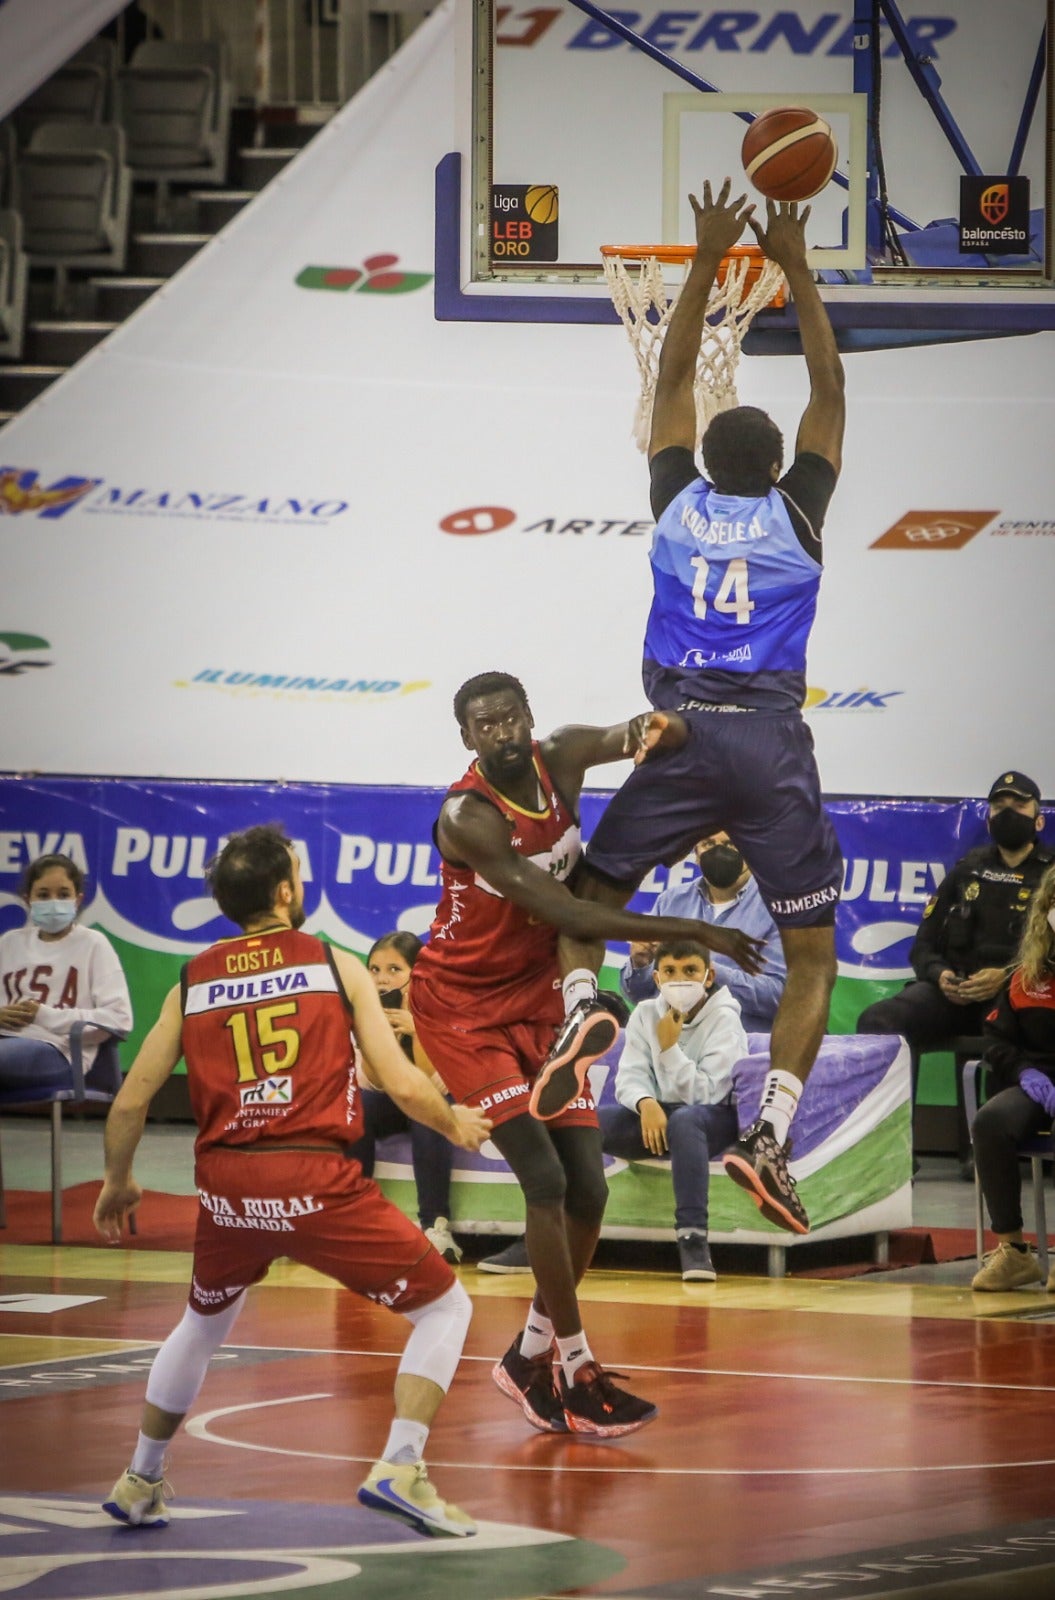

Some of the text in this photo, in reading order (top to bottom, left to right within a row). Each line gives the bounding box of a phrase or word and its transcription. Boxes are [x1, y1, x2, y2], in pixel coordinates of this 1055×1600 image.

[493, 194, 519, 212] Liga
[493, 221, 533, 239] LEB
[493, 241, 530, 256] ORO
[98, 487, 348, 519] MANZANO
[690, 555, 756, 625] 14
[225, 947, 284, 974] COSTA
[3, 965, 79, 1010] USA
[208, 971, 309, 1005] PULEVA
[225, 1001, 300, 1083] 15
[241, 1194, 325, 1219] RURAL
[212, 1214, 296, 1232] GRANADA
